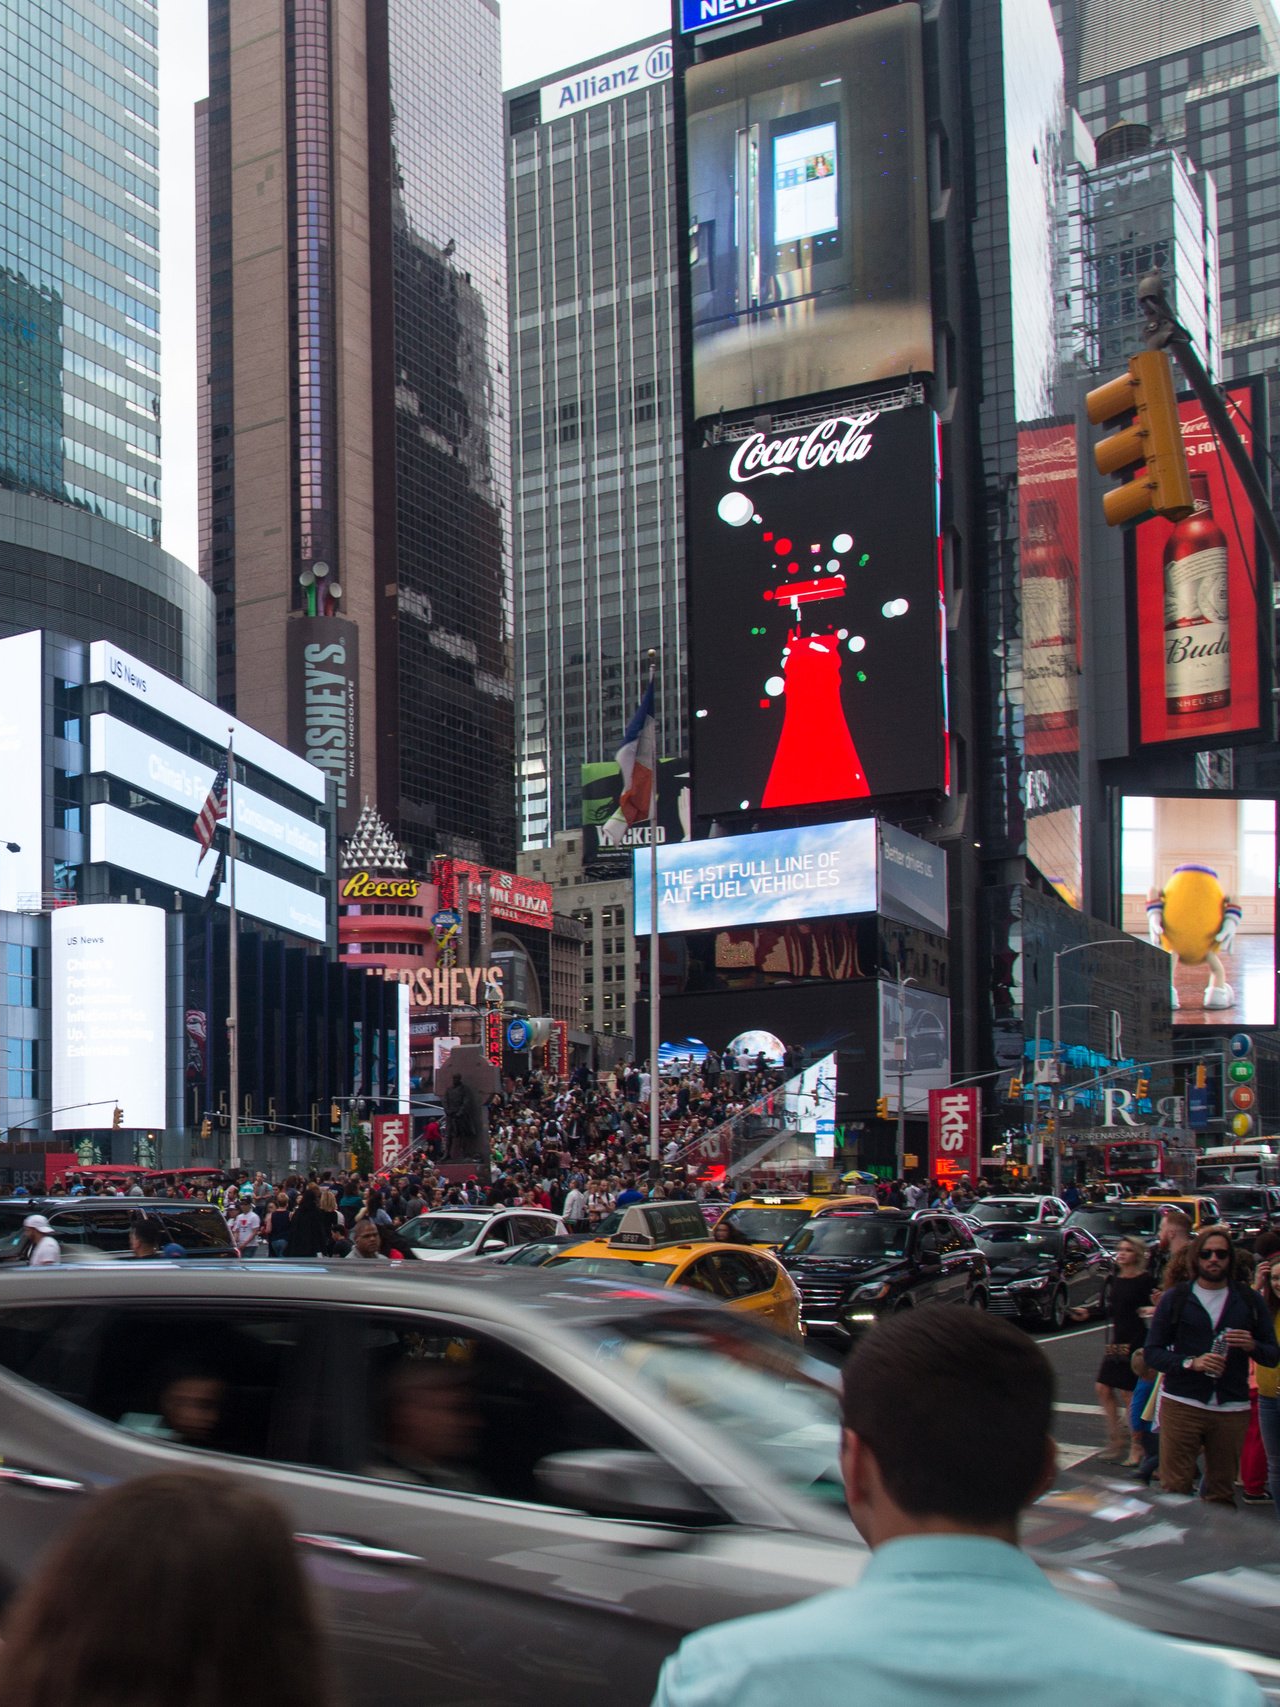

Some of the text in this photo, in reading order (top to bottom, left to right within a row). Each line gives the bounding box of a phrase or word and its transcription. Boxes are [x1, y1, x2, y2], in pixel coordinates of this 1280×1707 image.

[558, 62, 640, 109] Allianz
[729, 411, 880, 483] Coca-Cola
[109, 655, 148, 693] US News
[347, 680, 355, 748] CHOCOLATE
[304, 643, 347, 808] ERSHEY'S
[595, 825, 666, 846] WCKED
[884, 841, 905, 867] Better
[661, 851, 841, 887] THE 1ST FULL LINE OF
[341, 870, 421, 899] Reese's
[661, 869, 841, 905] ALT-FUEL VEHICLES
[514, 893, 549, 914] PLAZA
[493, 907, 518, 919] HOTEL
[66, 936, 105, 946] US News
[66, 957, 114, 972] China's
[66, 975, 117, 990] Factory,
[66, 992, 133, 1006] Consumer
[66, 1008, 148, 1023] Inflation Pick
[66, 1026, 155, 1042] Up, Exceeding
[66, 1044, 130, 1058] Estimates
[1232, 1042, 1241, 1050] m
[1235, 1067, 1248, 1075] m
[1240, 1093, 1250, 1102] m
[1102, 1088, 1146, 1127] R
[940, 1093, 970, 1151] tkts
[1233, 1120, 1241, 1129] m
[382, 1119, 404, 1166] tkts
[1089, 1131, 1150, 1141] RENAISSANCE
[13, 1170, 44, 1187] BEST
[622, 1233, 639, 1242] 9F87
